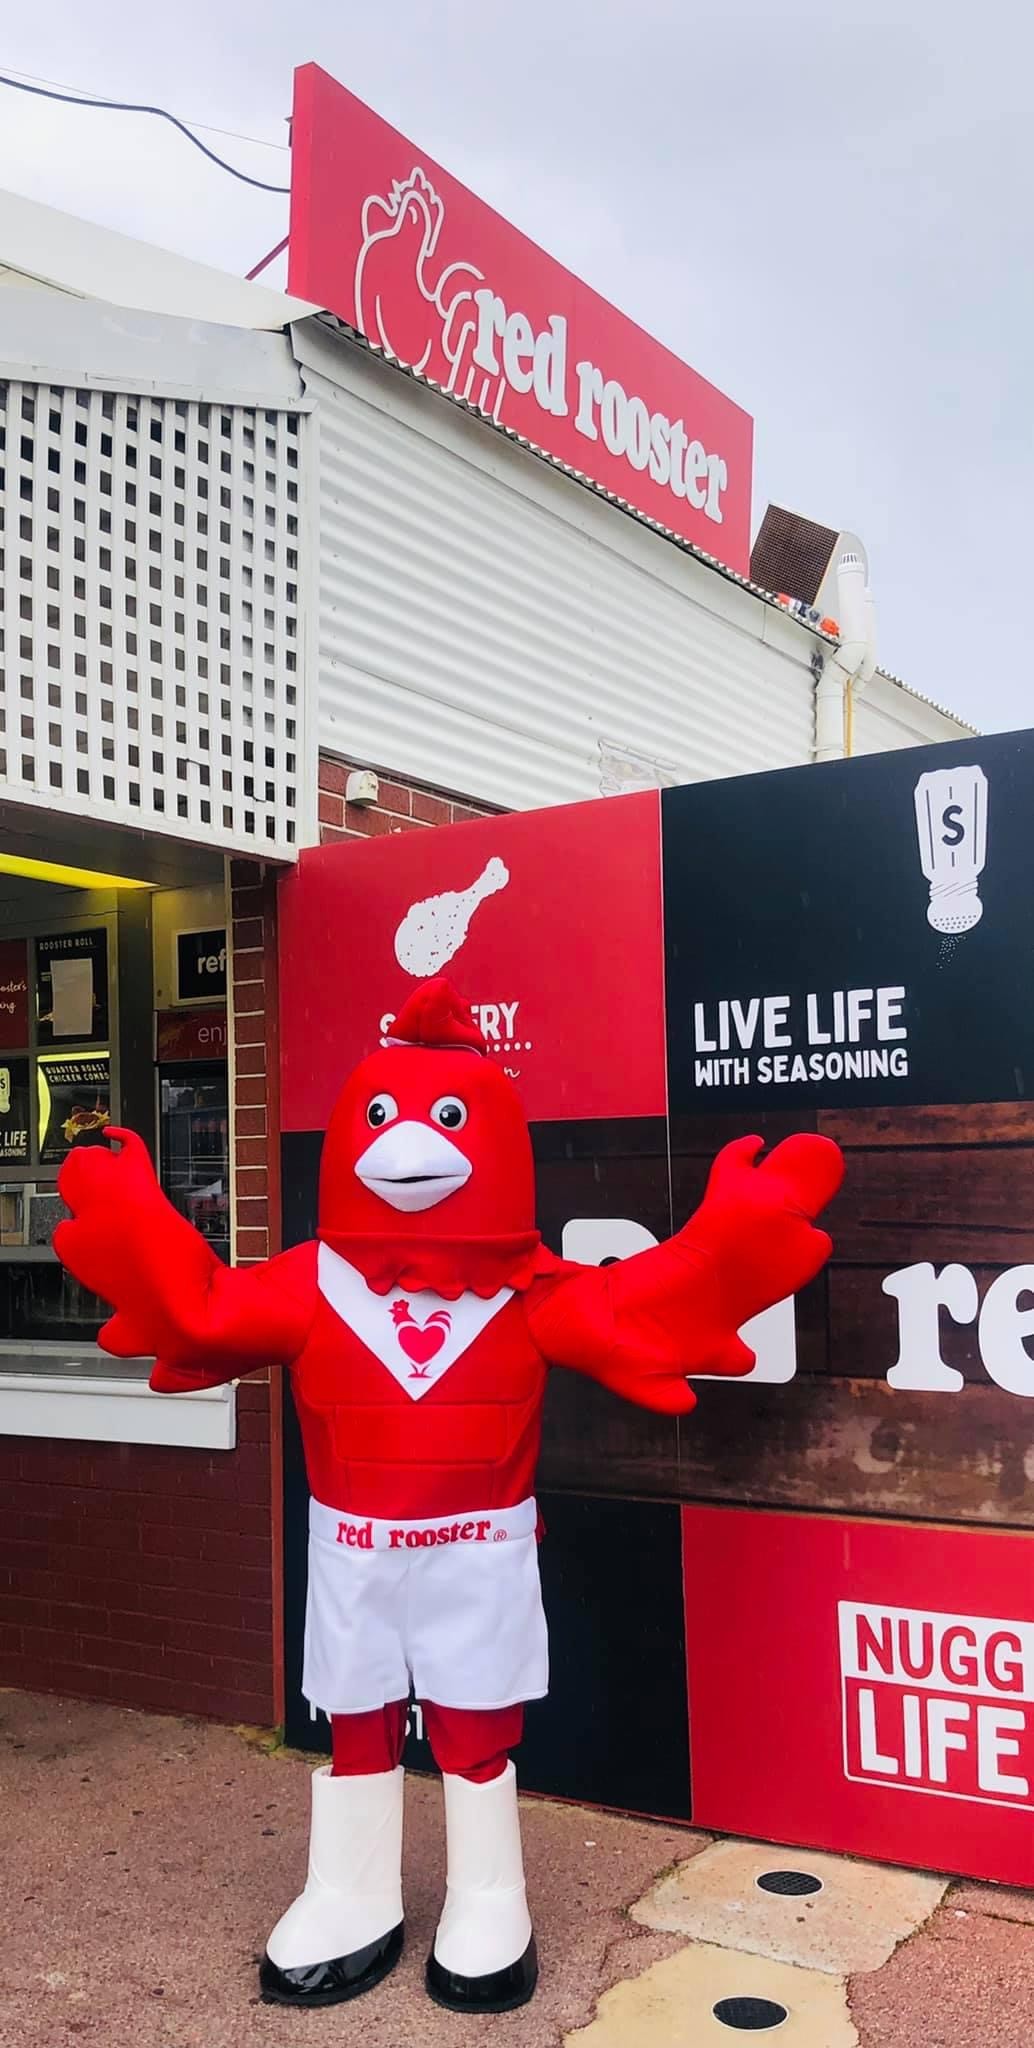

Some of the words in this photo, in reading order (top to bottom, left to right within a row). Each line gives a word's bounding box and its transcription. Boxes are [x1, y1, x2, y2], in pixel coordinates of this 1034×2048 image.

[472, 288, 568, 416] red
[575, 361, 728, 523] rooster
[942, 805, 965, 846] S
[197, 948, 226, 974] ref
[694, 996, 792, 1053] LIVE
[807, 986, 908, 1046] LIFE
[694, 1057, 750, 1088] WITH
[757, 1048, 909, 1084] SEASONING
[4, 1130, 28, 1147] LIFE
[336, 1521, 374, 1549] red
[856, 1613, 1024, 1693] NUGG
[858, 1688, 1029, 1796] LIFE
